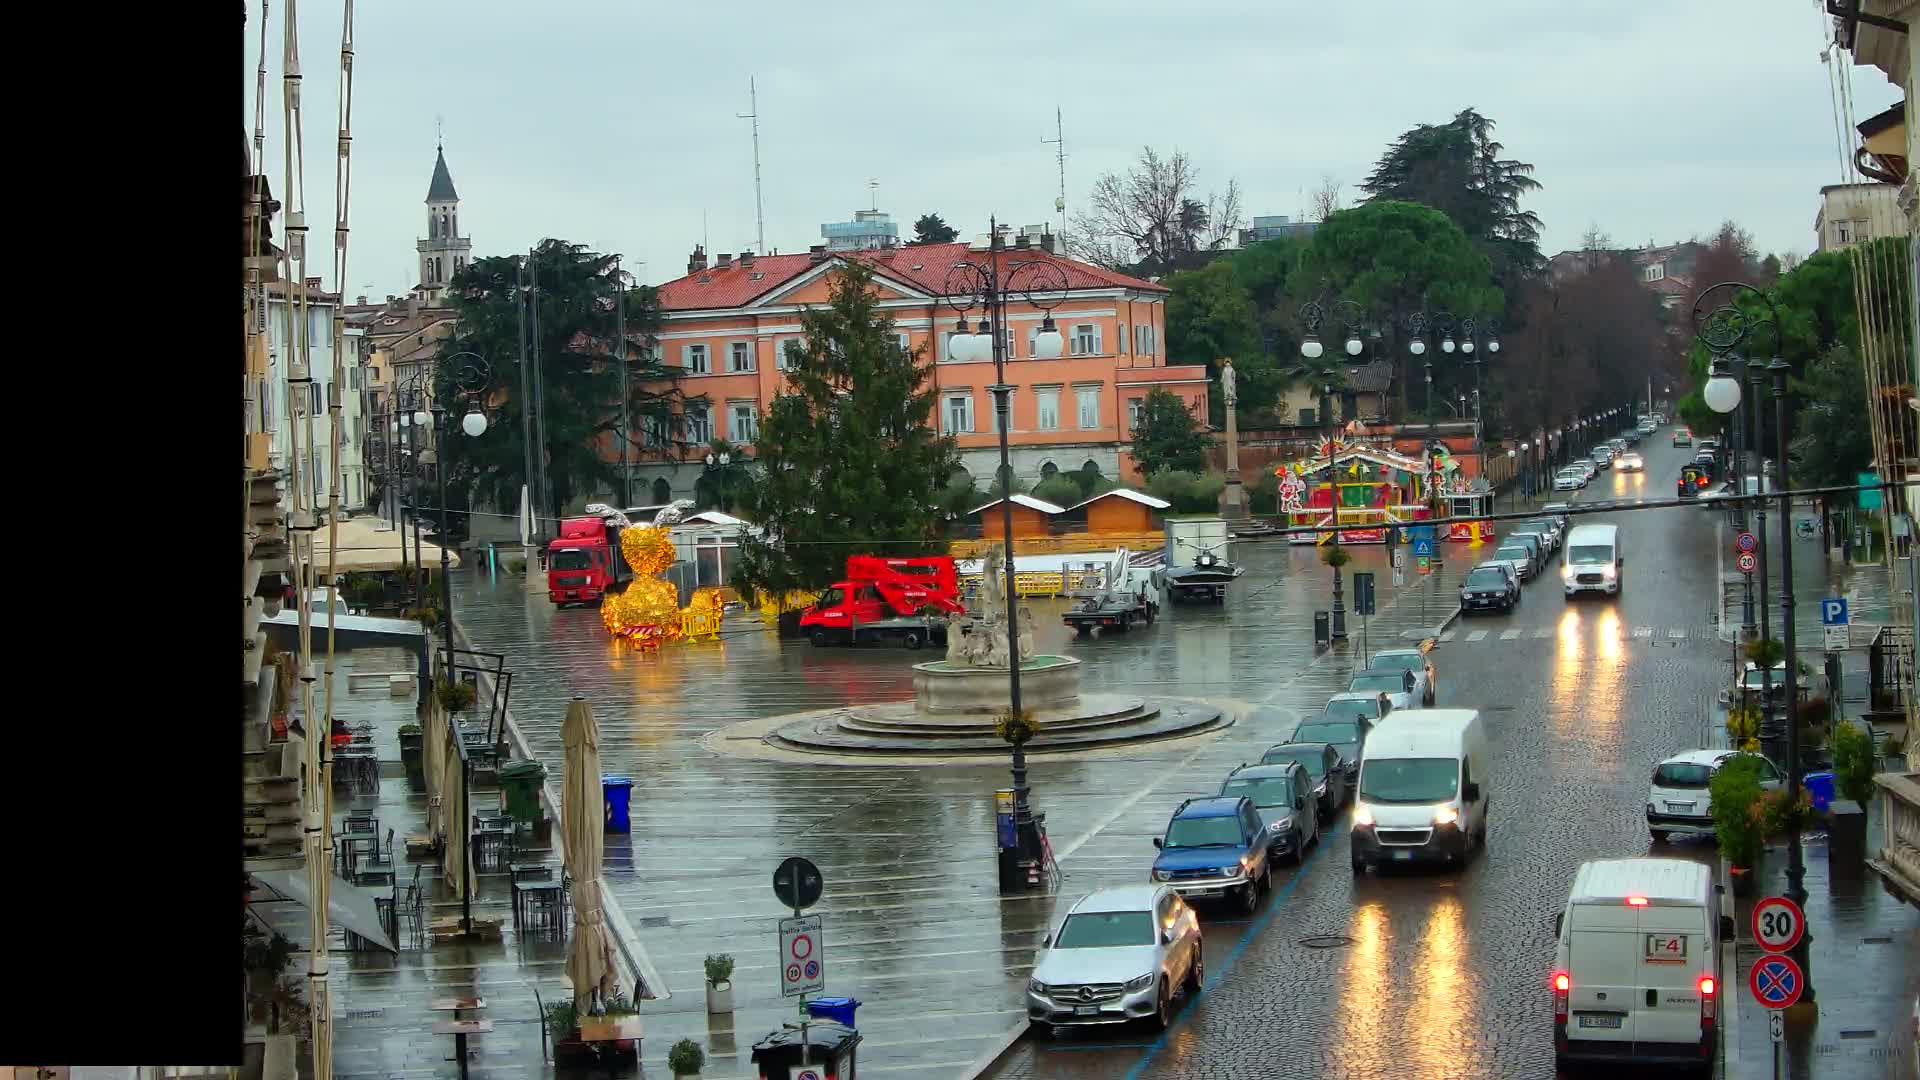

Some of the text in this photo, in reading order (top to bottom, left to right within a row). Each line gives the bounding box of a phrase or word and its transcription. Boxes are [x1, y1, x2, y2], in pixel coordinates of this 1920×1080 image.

[1742, 557, 1753, 567] 20
[1827, 602, 1842, 622] P
[1763, 911, 1791, 938] 30
